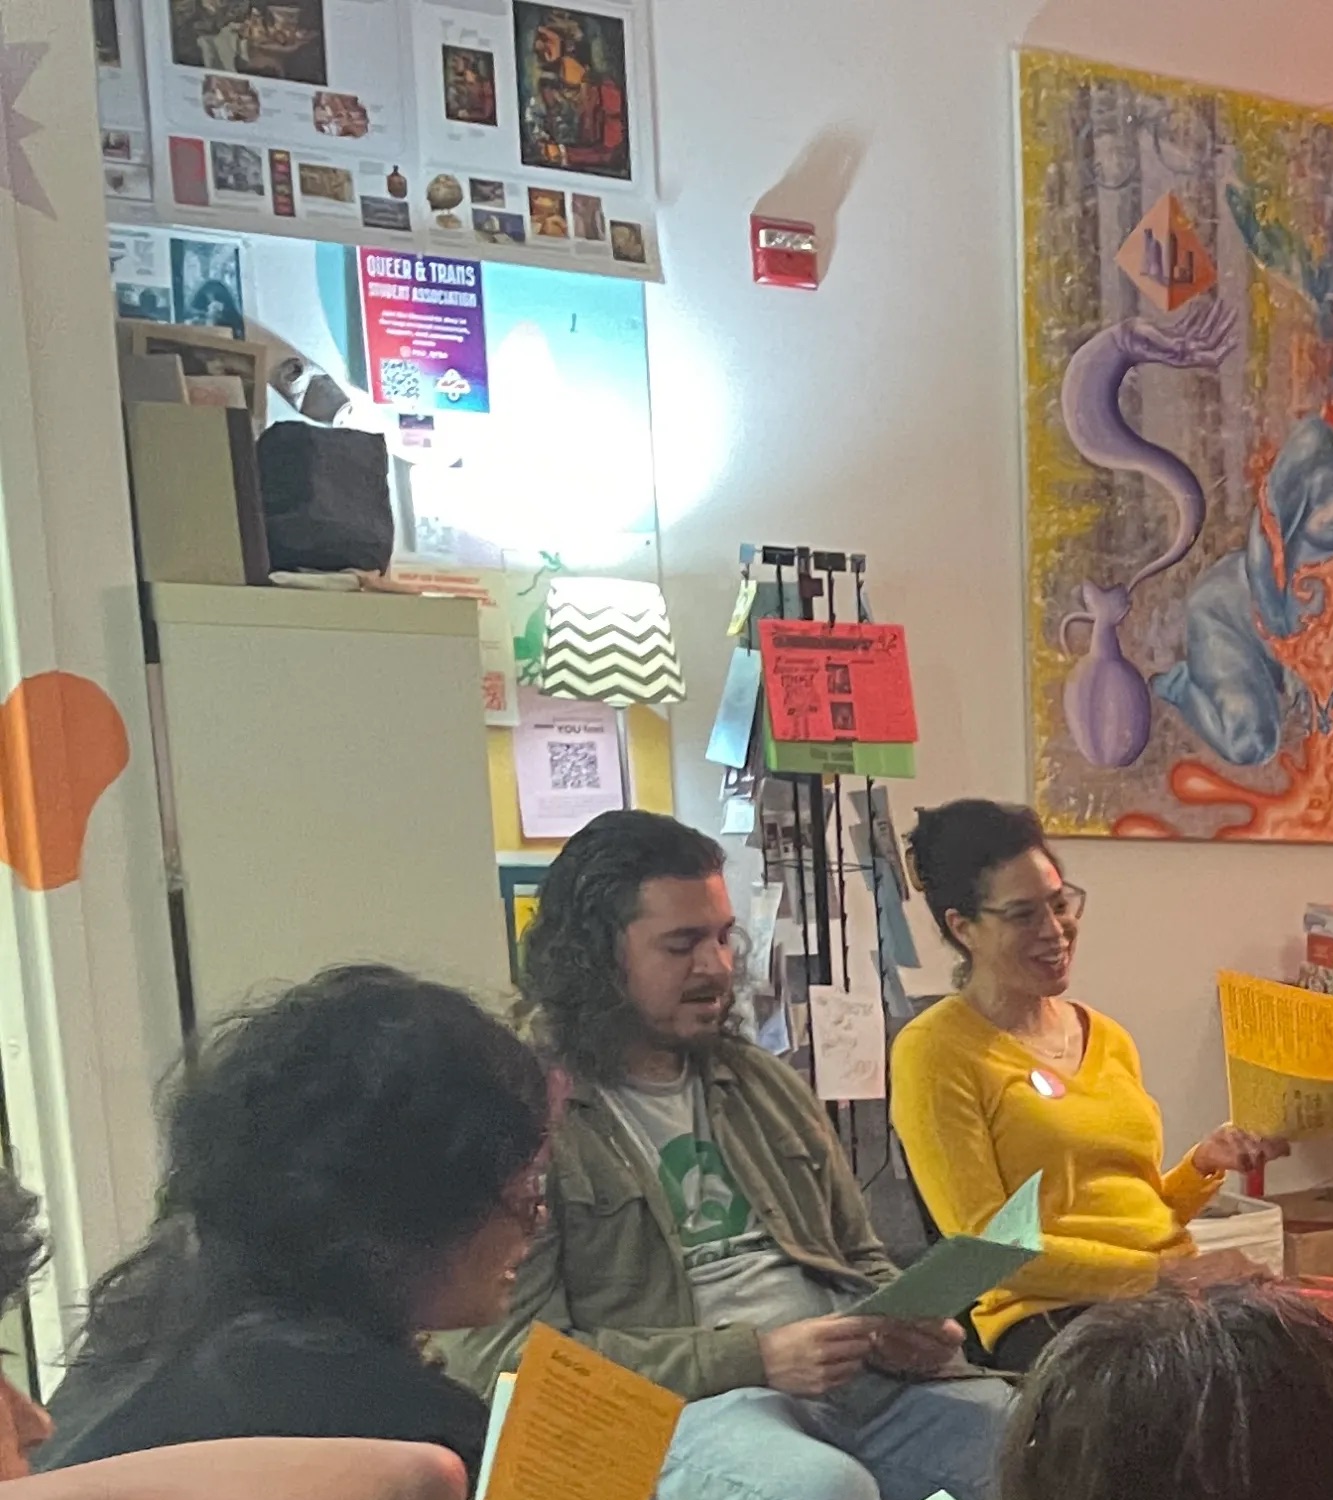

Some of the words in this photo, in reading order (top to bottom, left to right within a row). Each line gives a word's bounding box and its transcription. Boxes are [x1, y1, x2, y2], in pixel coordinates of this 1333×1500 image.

[366, 255, 412, 280] QUEER
[415, 261, 427, 282] &
[429, 262, 476, 287] TRANS
[412, 287, 477, 308] ASSOCIATION
[557, 724, 581, 733] YOU
